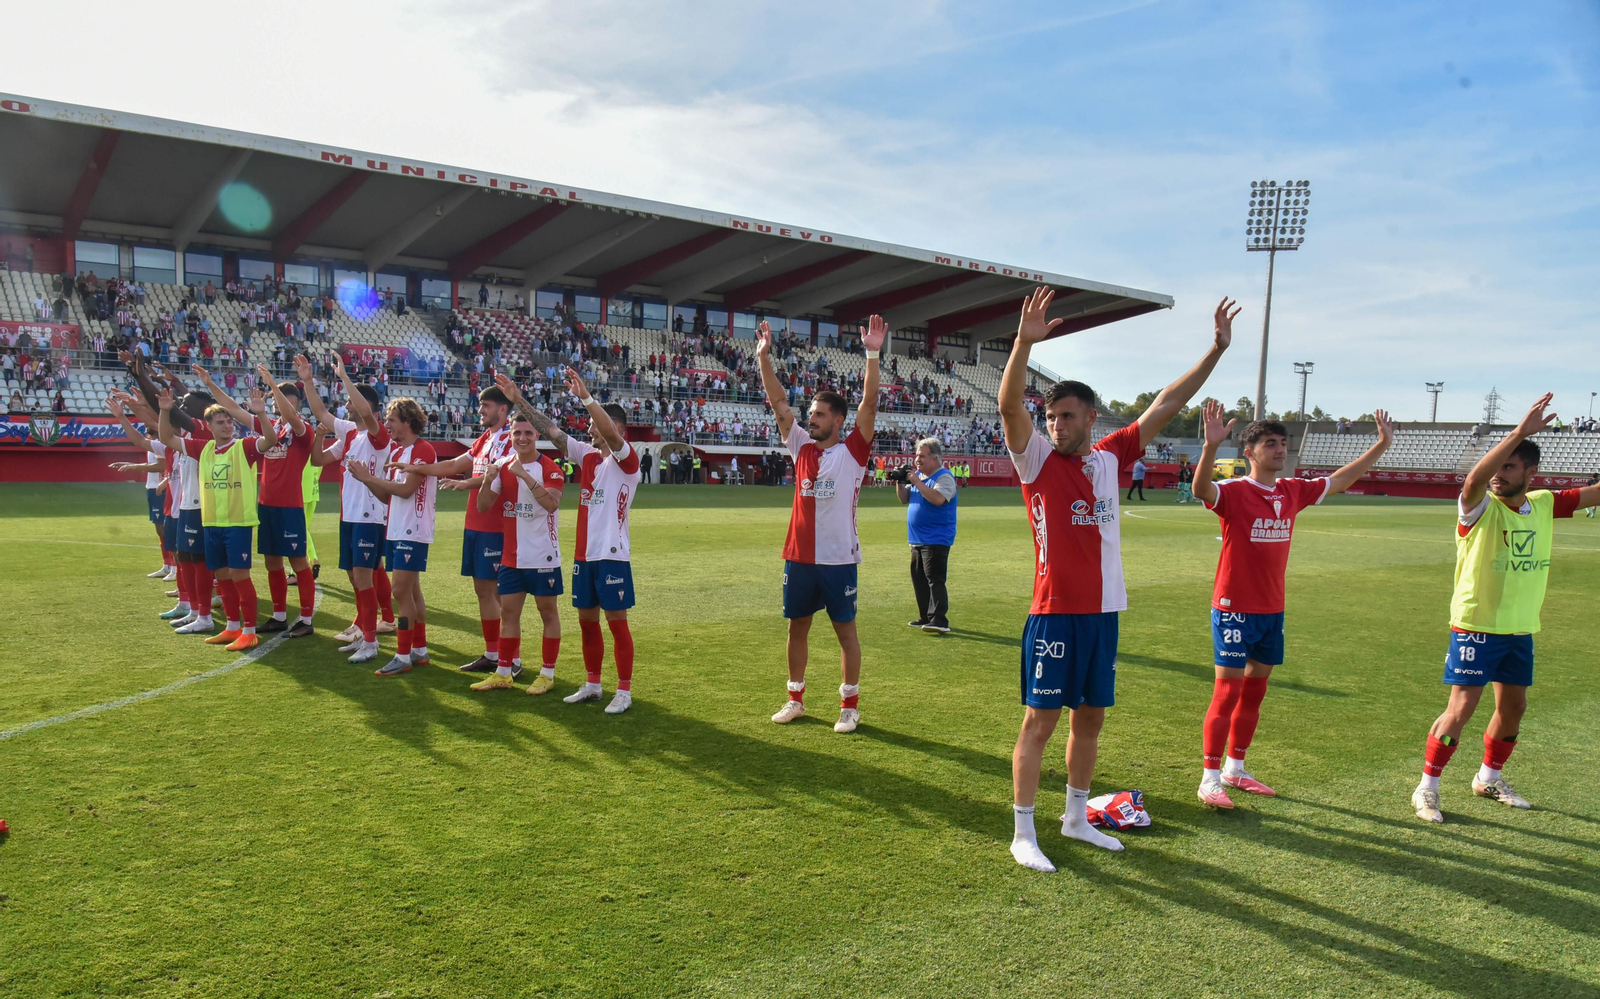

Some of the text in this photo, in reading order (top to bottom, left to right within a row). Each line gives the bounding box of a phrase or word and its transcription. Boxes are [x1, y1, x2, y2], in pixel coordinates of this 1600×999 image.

[321, 151, 1044, 282] MUNICIPAL NUEVO MIRADOR
[980, 461, 994, 473] ICC
[204, 481, 242, 490] GIVOVA
[1223, 628, 1242, 644] 28
[1219, 650, 1247, 658] GIVOVA
[1458, 645, 1476, 662] 18
[1035, 661, 1043, 680] 8
[1032, 687, 1062, 695] GIVOVA
